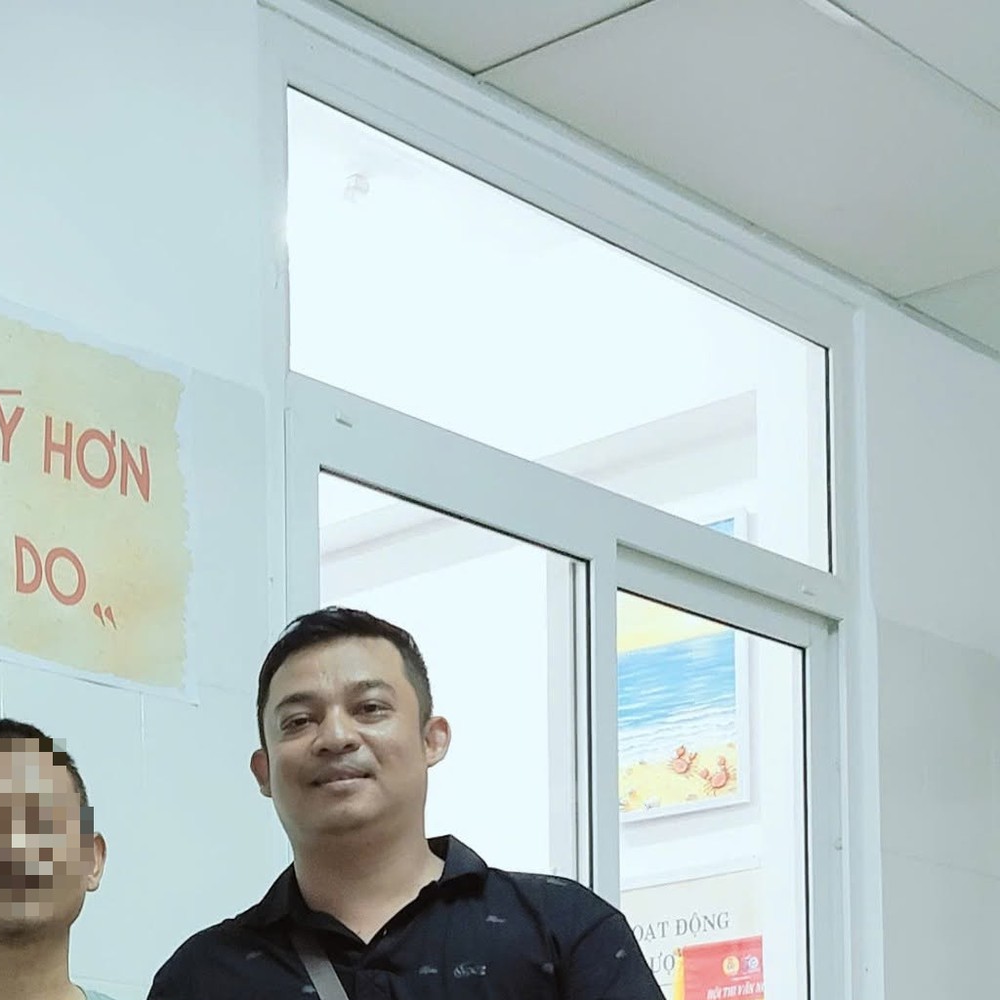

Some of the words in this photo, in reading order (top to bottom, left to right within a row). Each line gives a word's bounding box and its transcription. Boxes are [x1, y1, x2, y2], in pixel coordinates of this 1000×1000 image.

[44, 416, 150, 502] HƠN
[633, 921, 669, 942] OẠT
[676, 912, 730, 938] ĐỘNG
